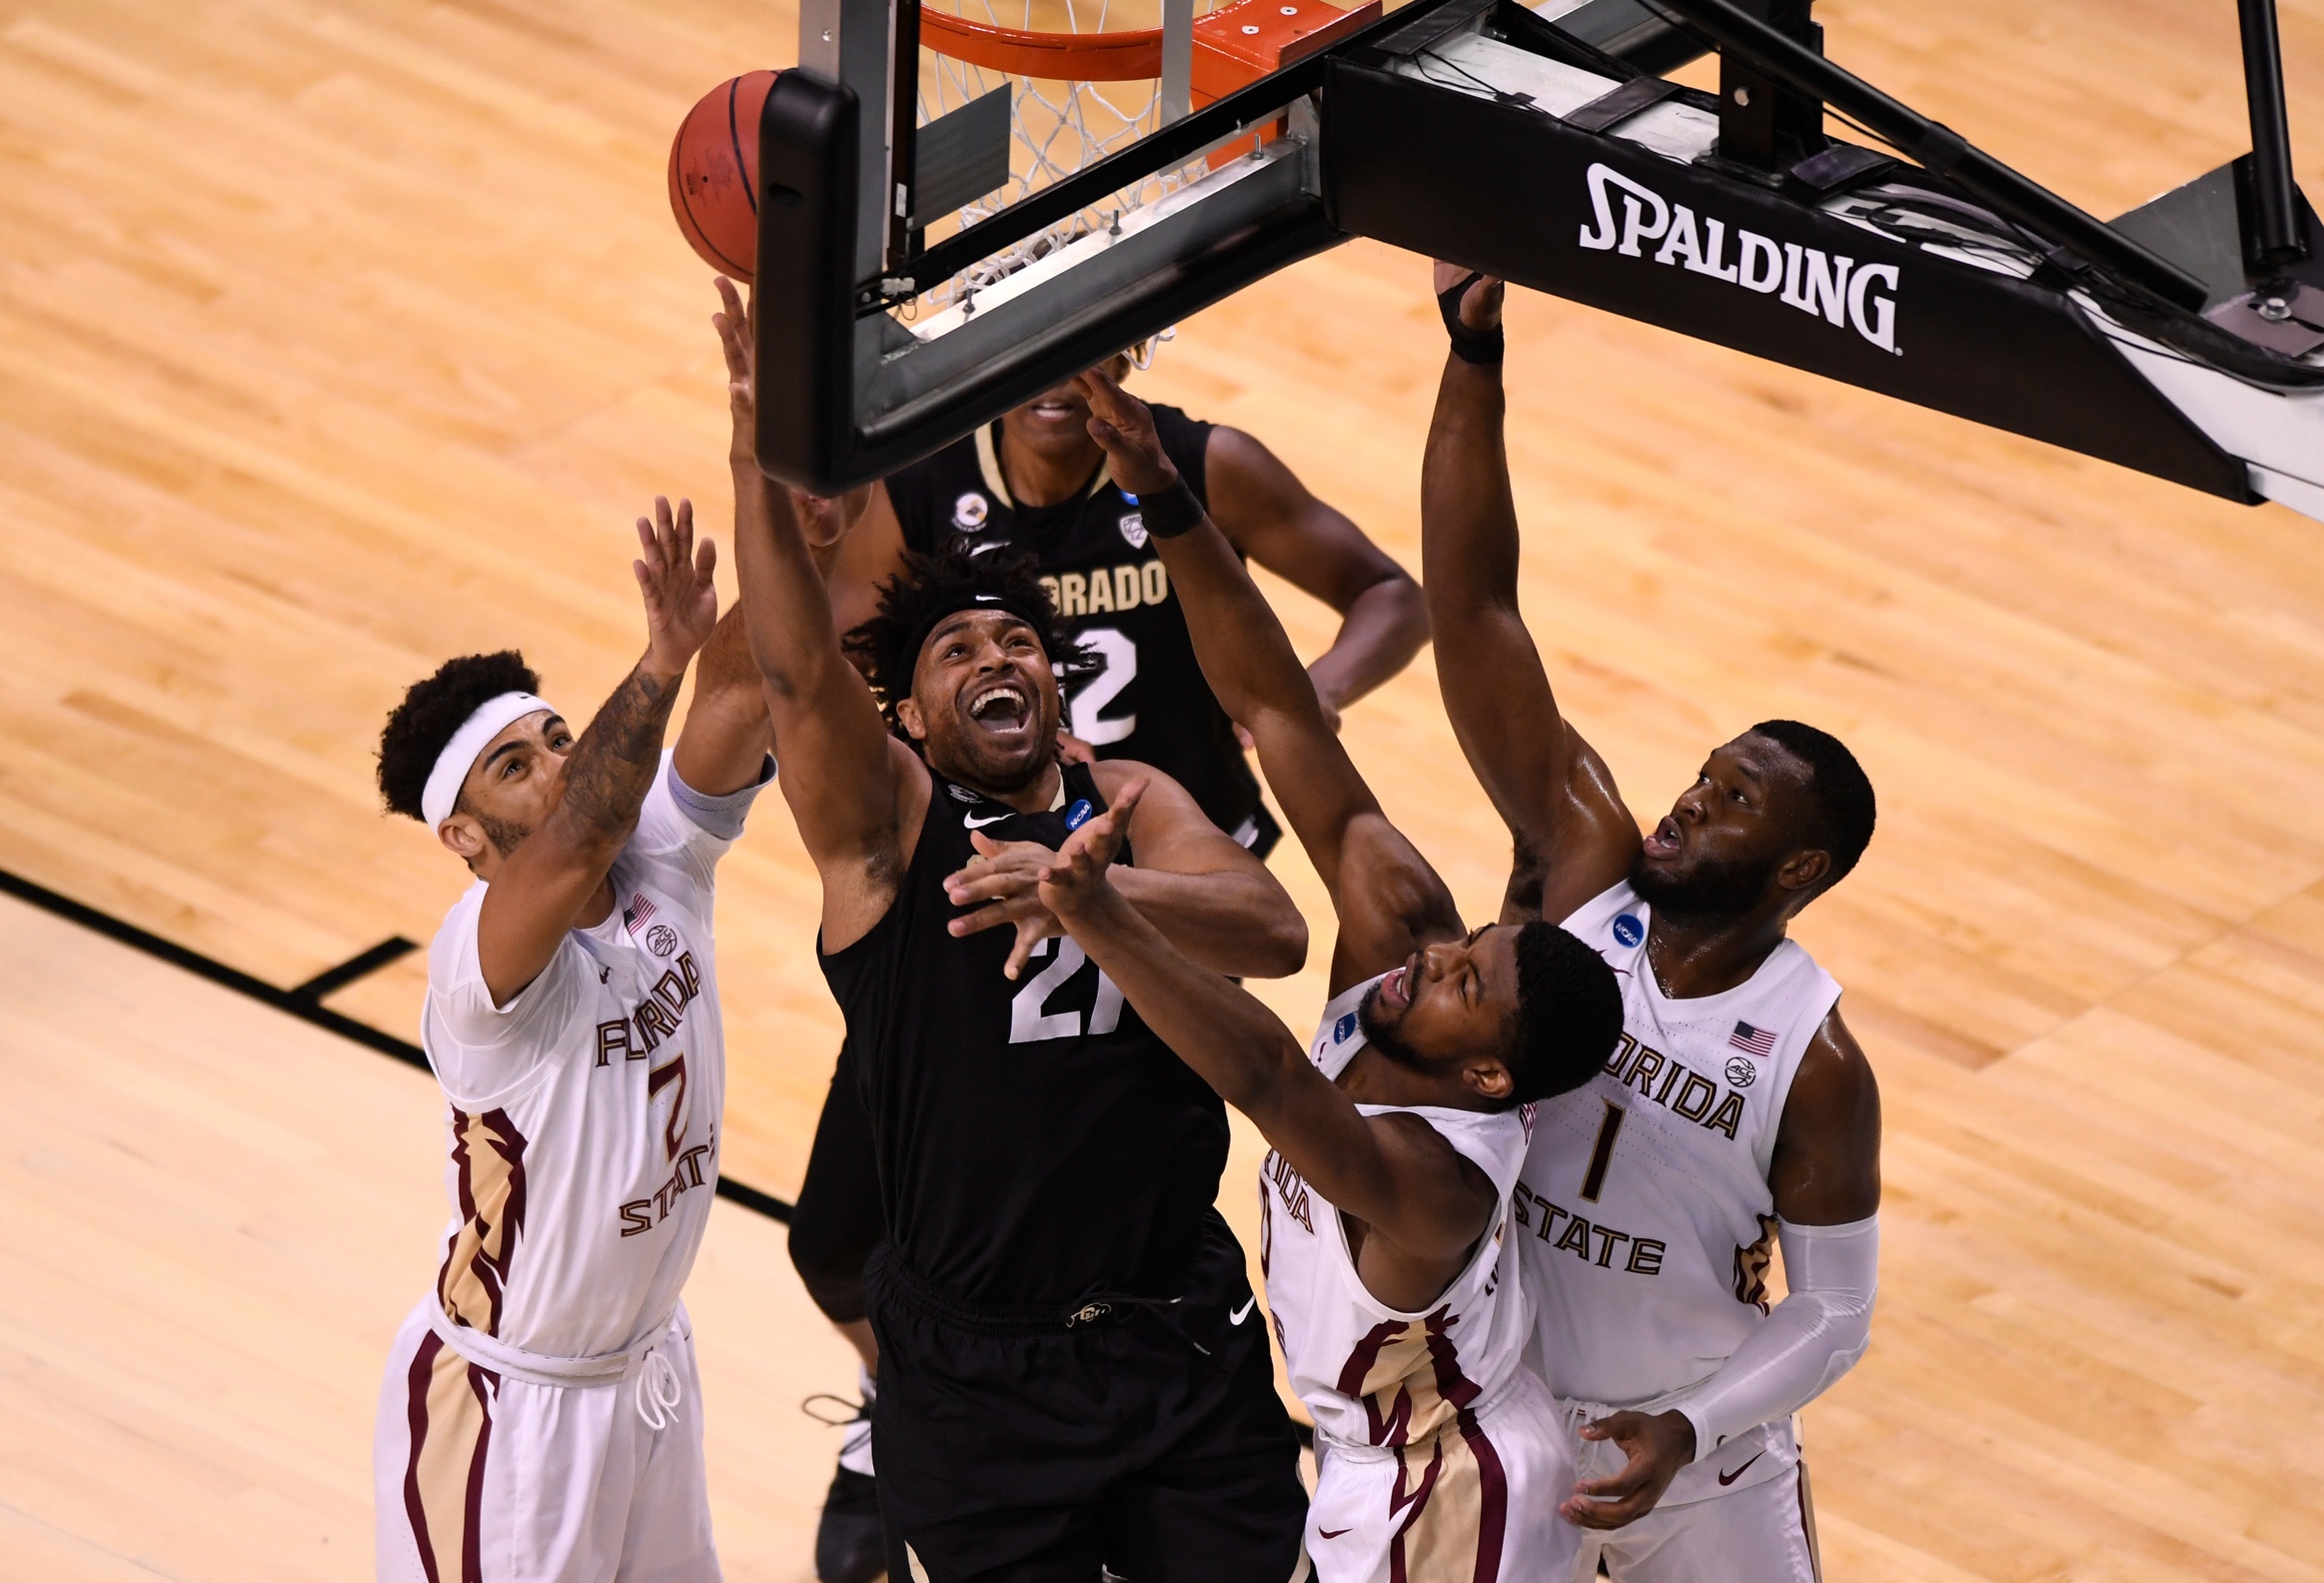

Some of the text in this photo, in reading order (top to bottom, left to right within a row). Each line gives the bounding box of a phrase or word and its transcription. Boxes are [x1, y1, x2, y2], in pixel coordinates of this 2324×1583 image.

[1579, 162, 1901, 355] SPALDING
[1069, 802, 1091, 828] NCAA
[653, 927, 672, 950] ACC
[1615, 921, 1639, 945] NCAA
[1729, 1064, 1756, 1079] ACC
[1578, 1095, 1627, 1205] 1
[1513, 1178, 1667, 1276] STATE
